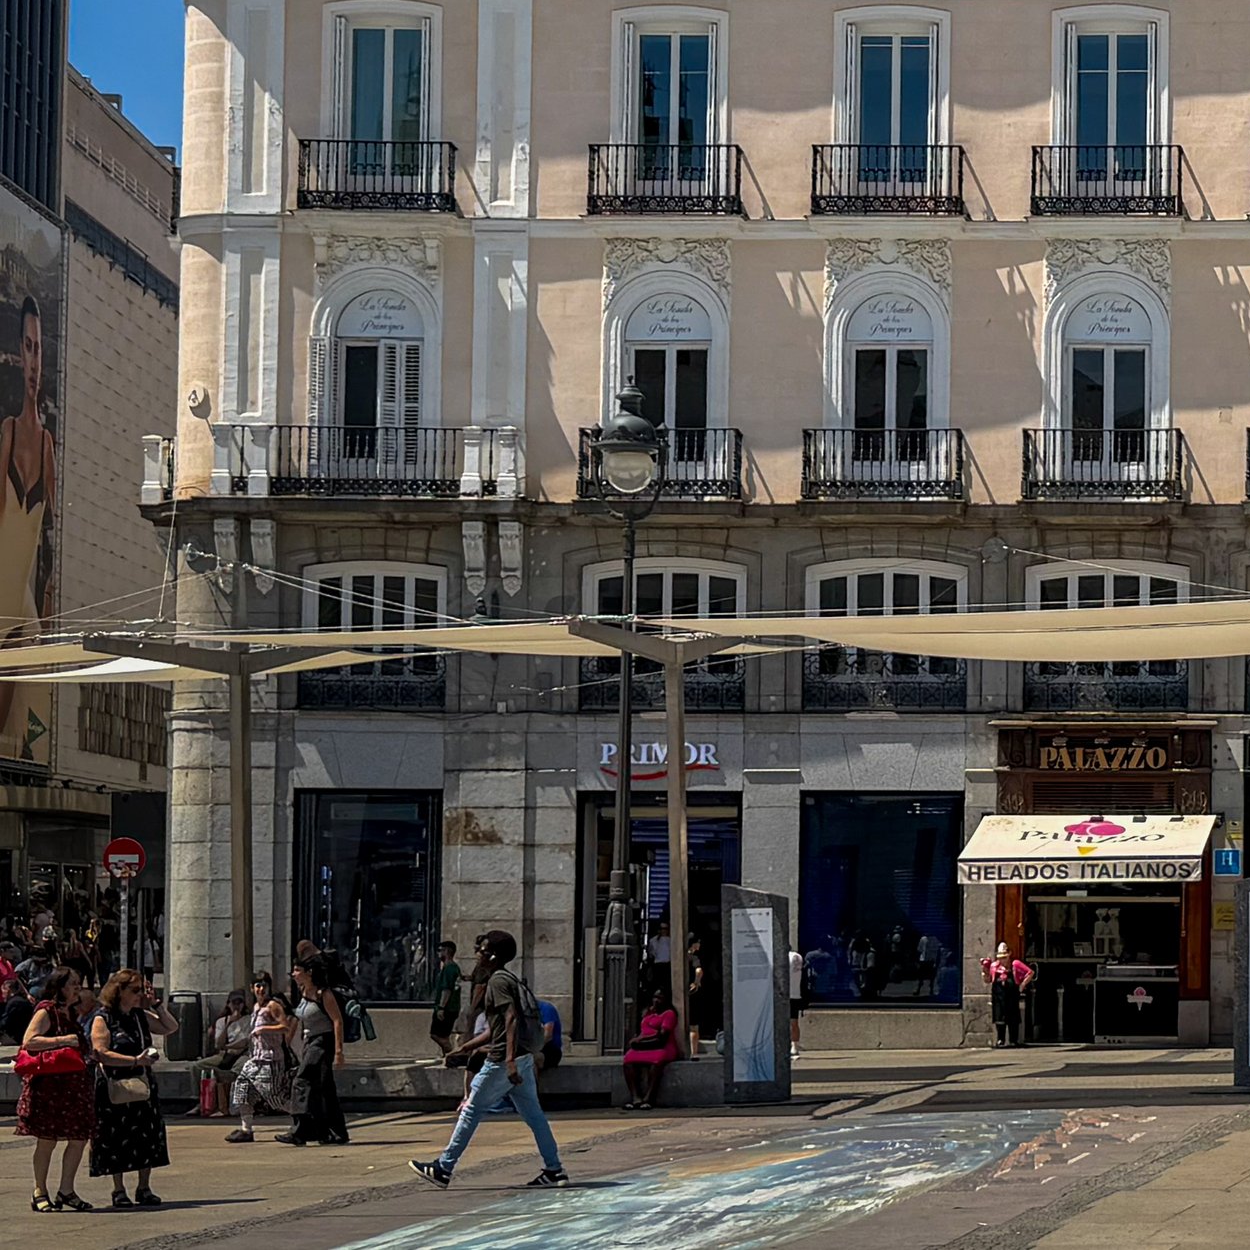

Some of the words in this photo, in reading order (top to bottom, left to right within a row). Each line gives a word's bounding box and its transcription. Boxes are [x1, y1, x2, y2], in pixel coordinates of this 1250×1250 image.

[1040, 746, 1167, 769] PALAZZO
[1221, 851, 1233, 866] H
[967, 864, 1069, 881] HELADOS
[1080, 862, 1192, 880] ITALIANOS
